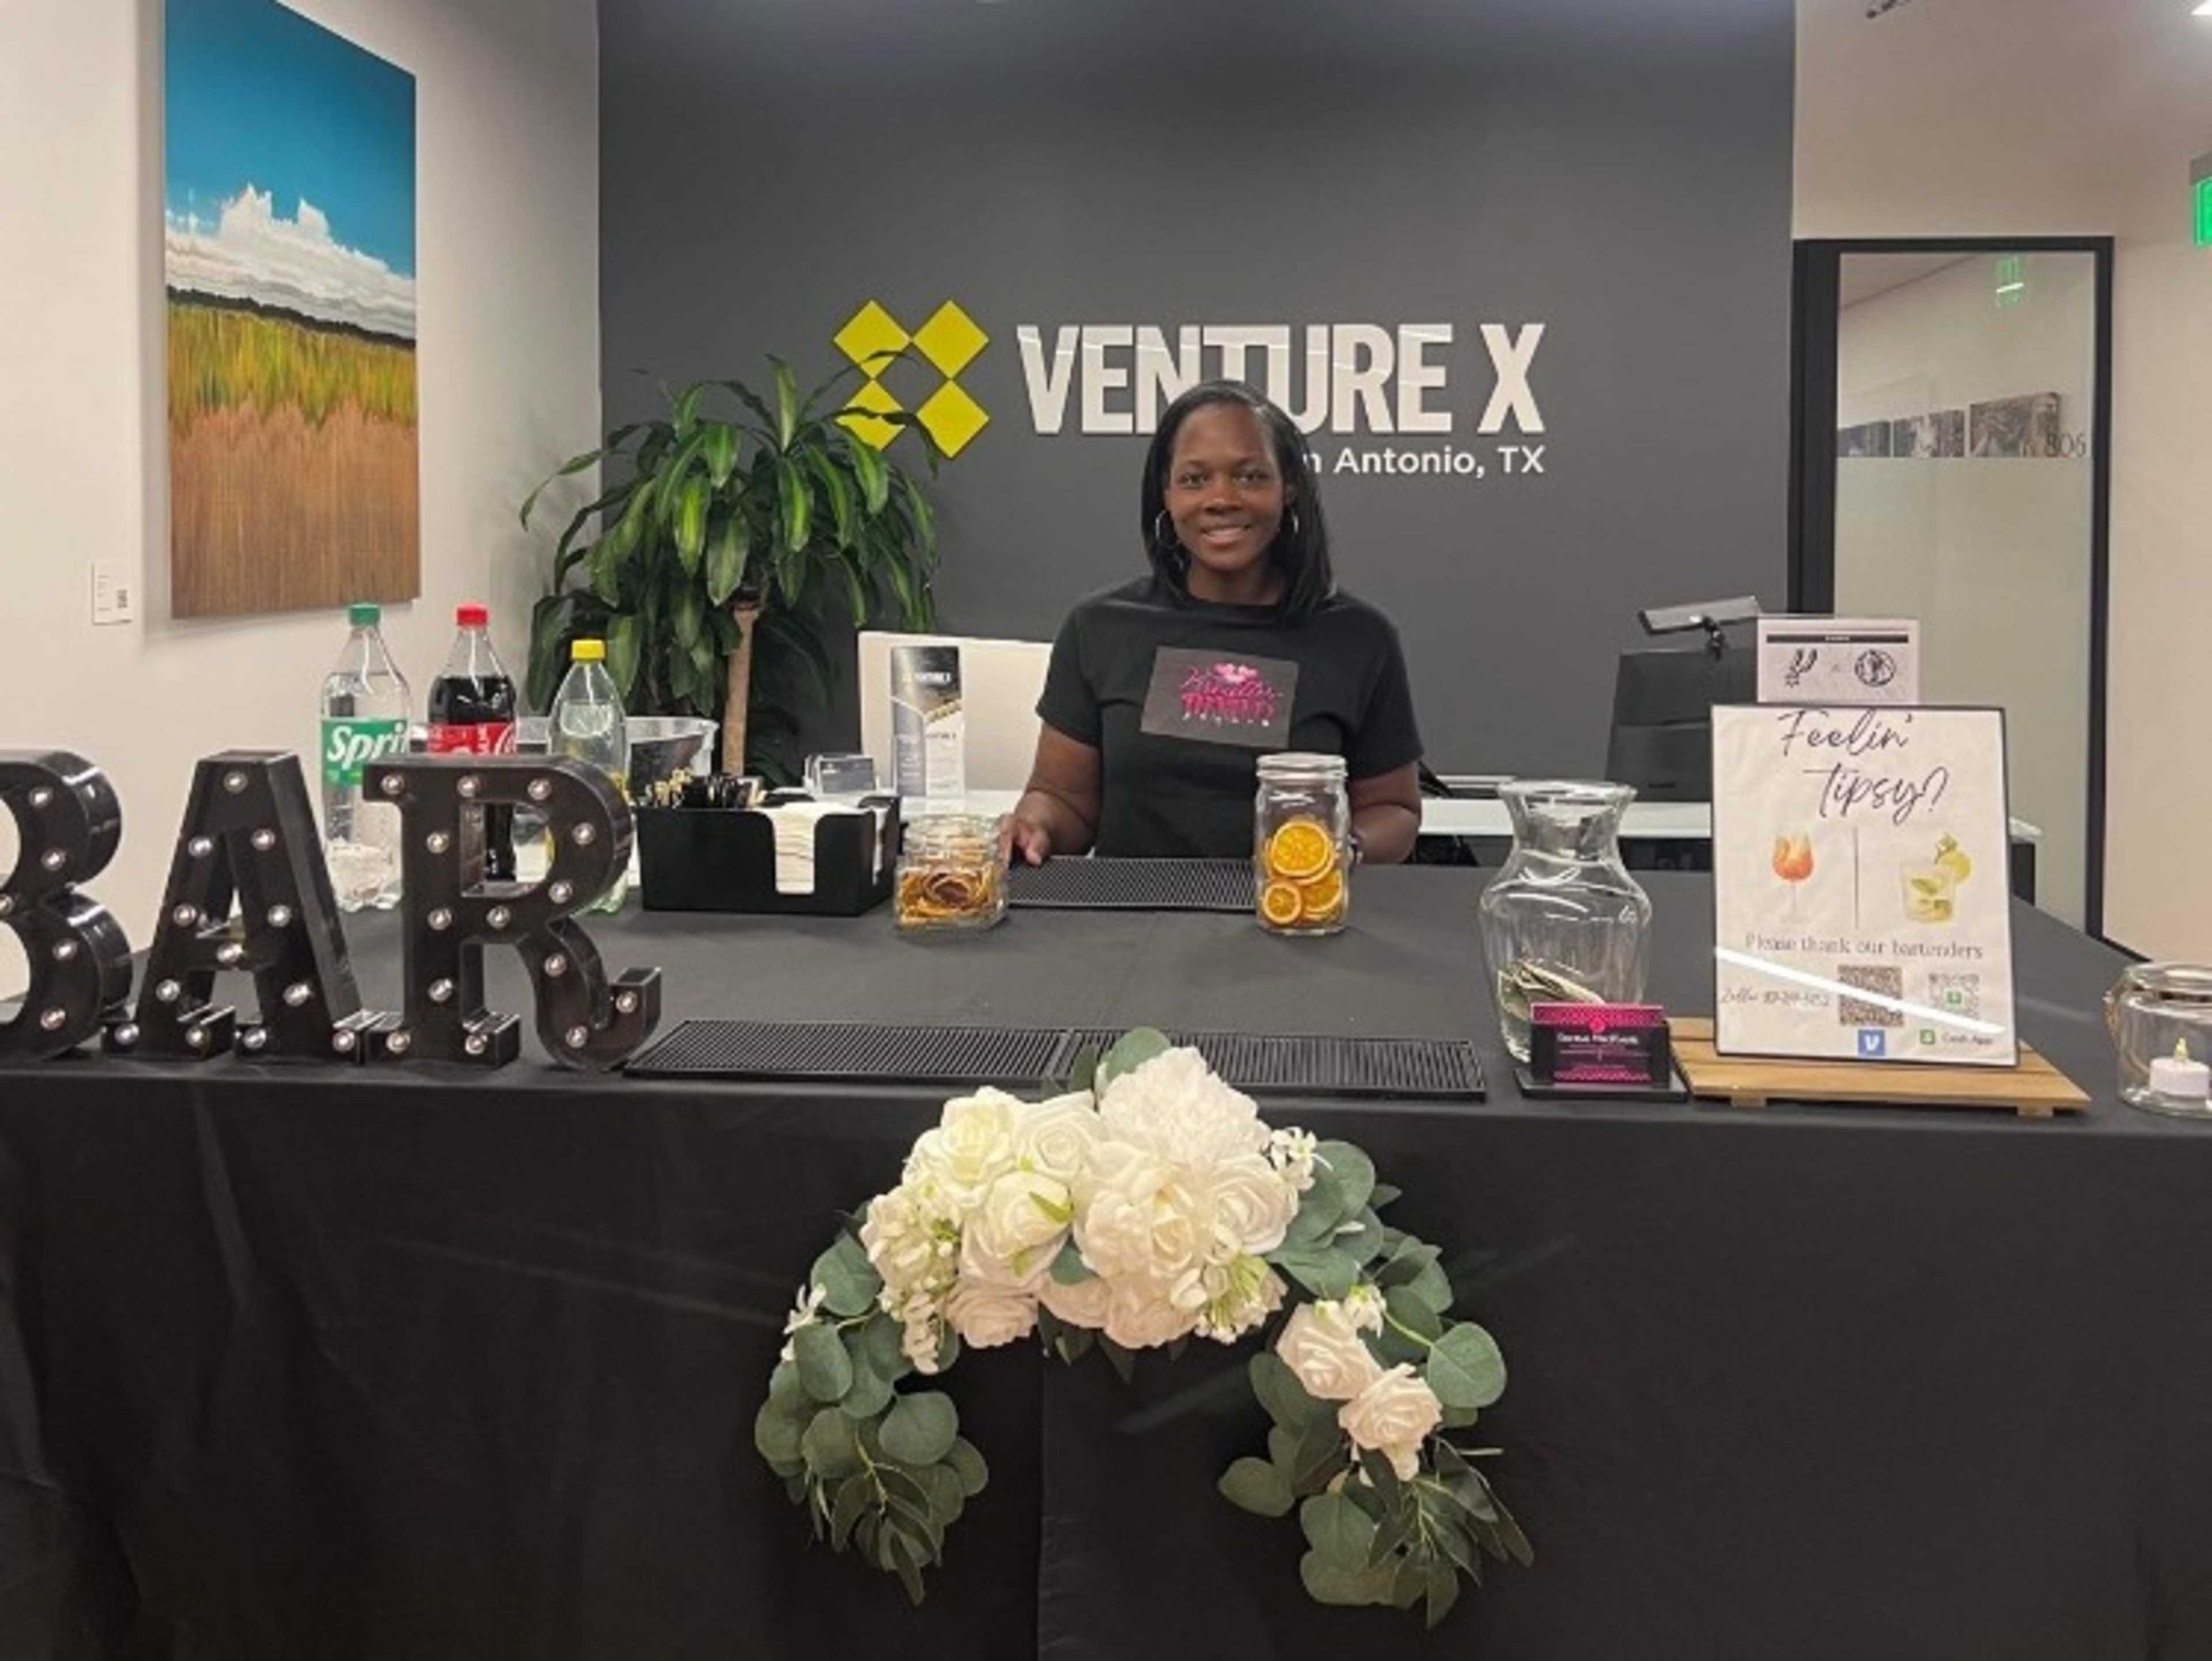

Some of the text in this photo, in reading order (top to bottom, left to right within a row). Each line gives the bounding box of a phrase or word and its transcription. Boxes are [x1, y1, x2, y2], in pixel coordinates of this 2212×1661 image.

[1016, 323, 1546, 434] VENTURE X
[1332, 445, 1486, 479] Antonio,
[1497, 445, 1546, 474] TX
[1777, 708, 1912, 756] Feelin'
[1744, 933, 1983, 959] Please thank our bartenders
